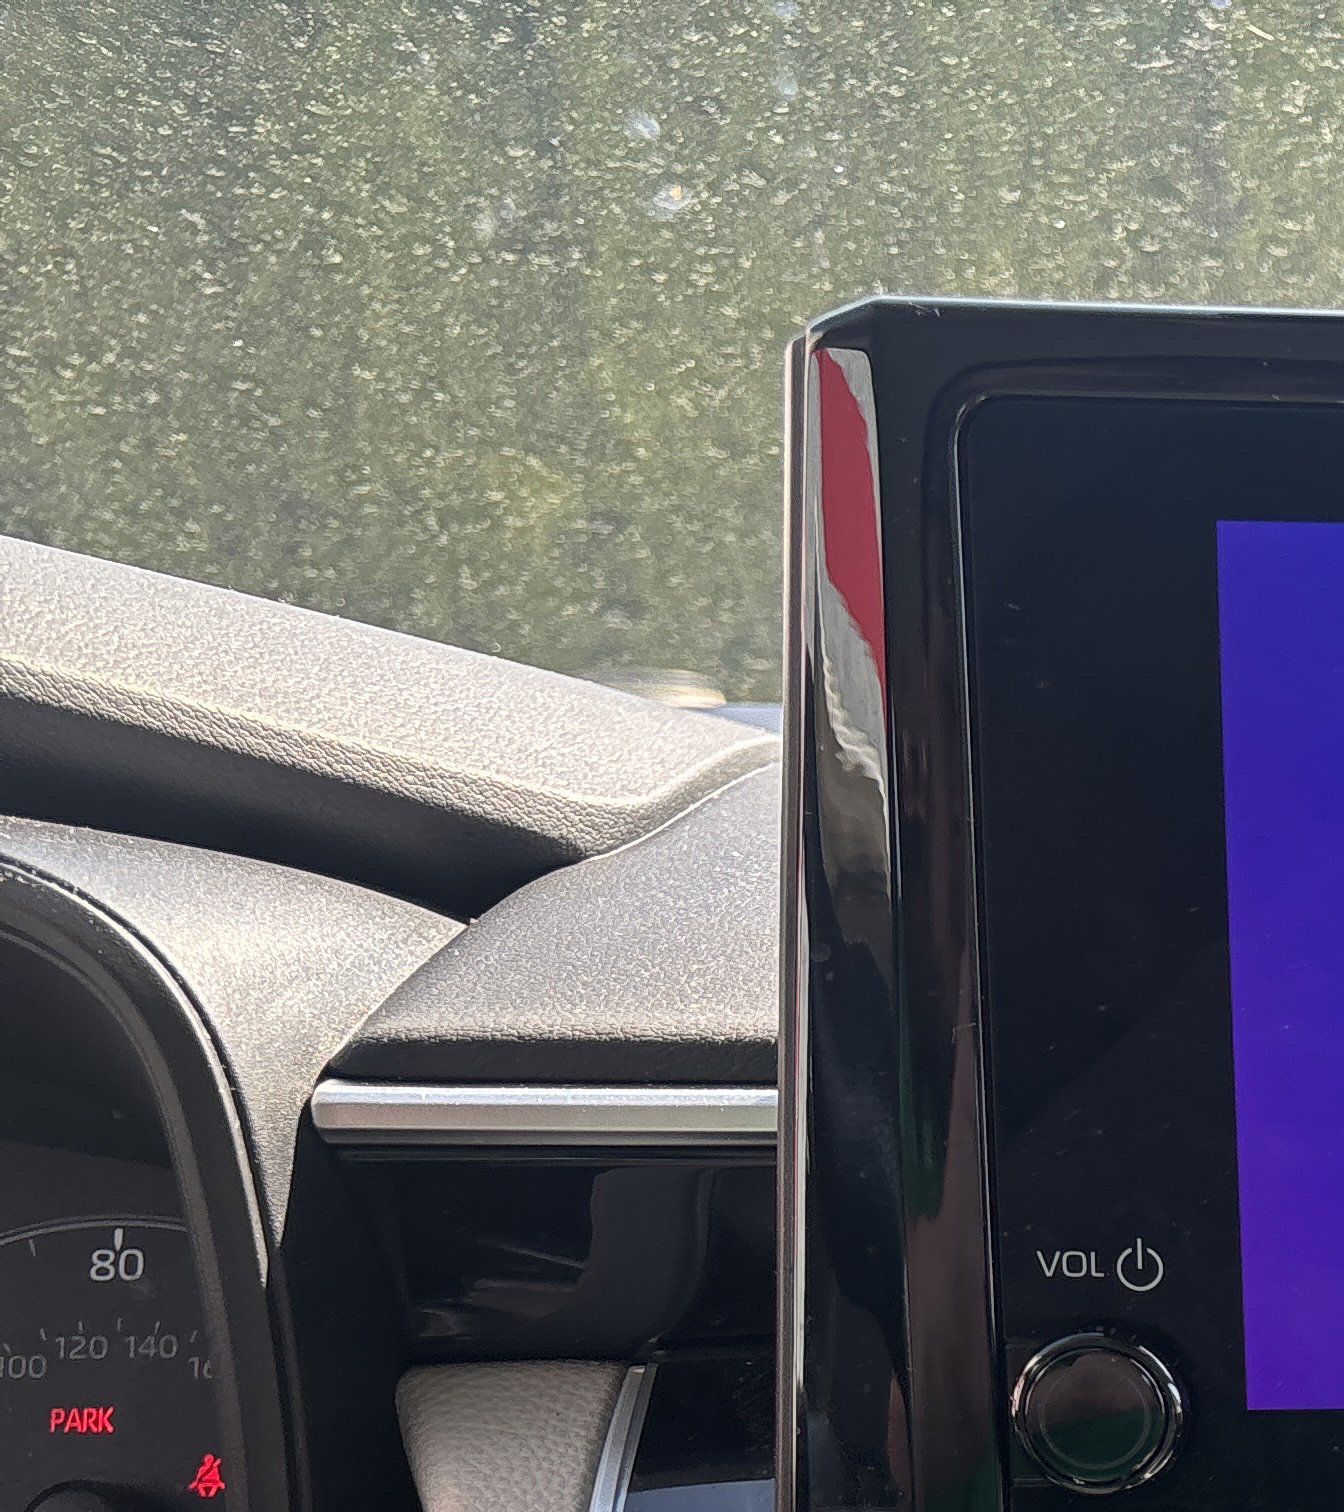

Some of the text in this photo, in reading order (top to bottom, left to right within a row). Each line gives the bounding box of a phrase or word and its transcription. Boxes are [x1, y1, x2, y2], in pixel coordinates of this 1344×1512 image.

[89, 1250, 144, 1281] 80
[1036, 1250, 1105, 1278] VOL
[55, 1335, 108, 1360] 120
[124, 1334, 178, 1359] 140
[50, 1407, 114, 1433] PARK
